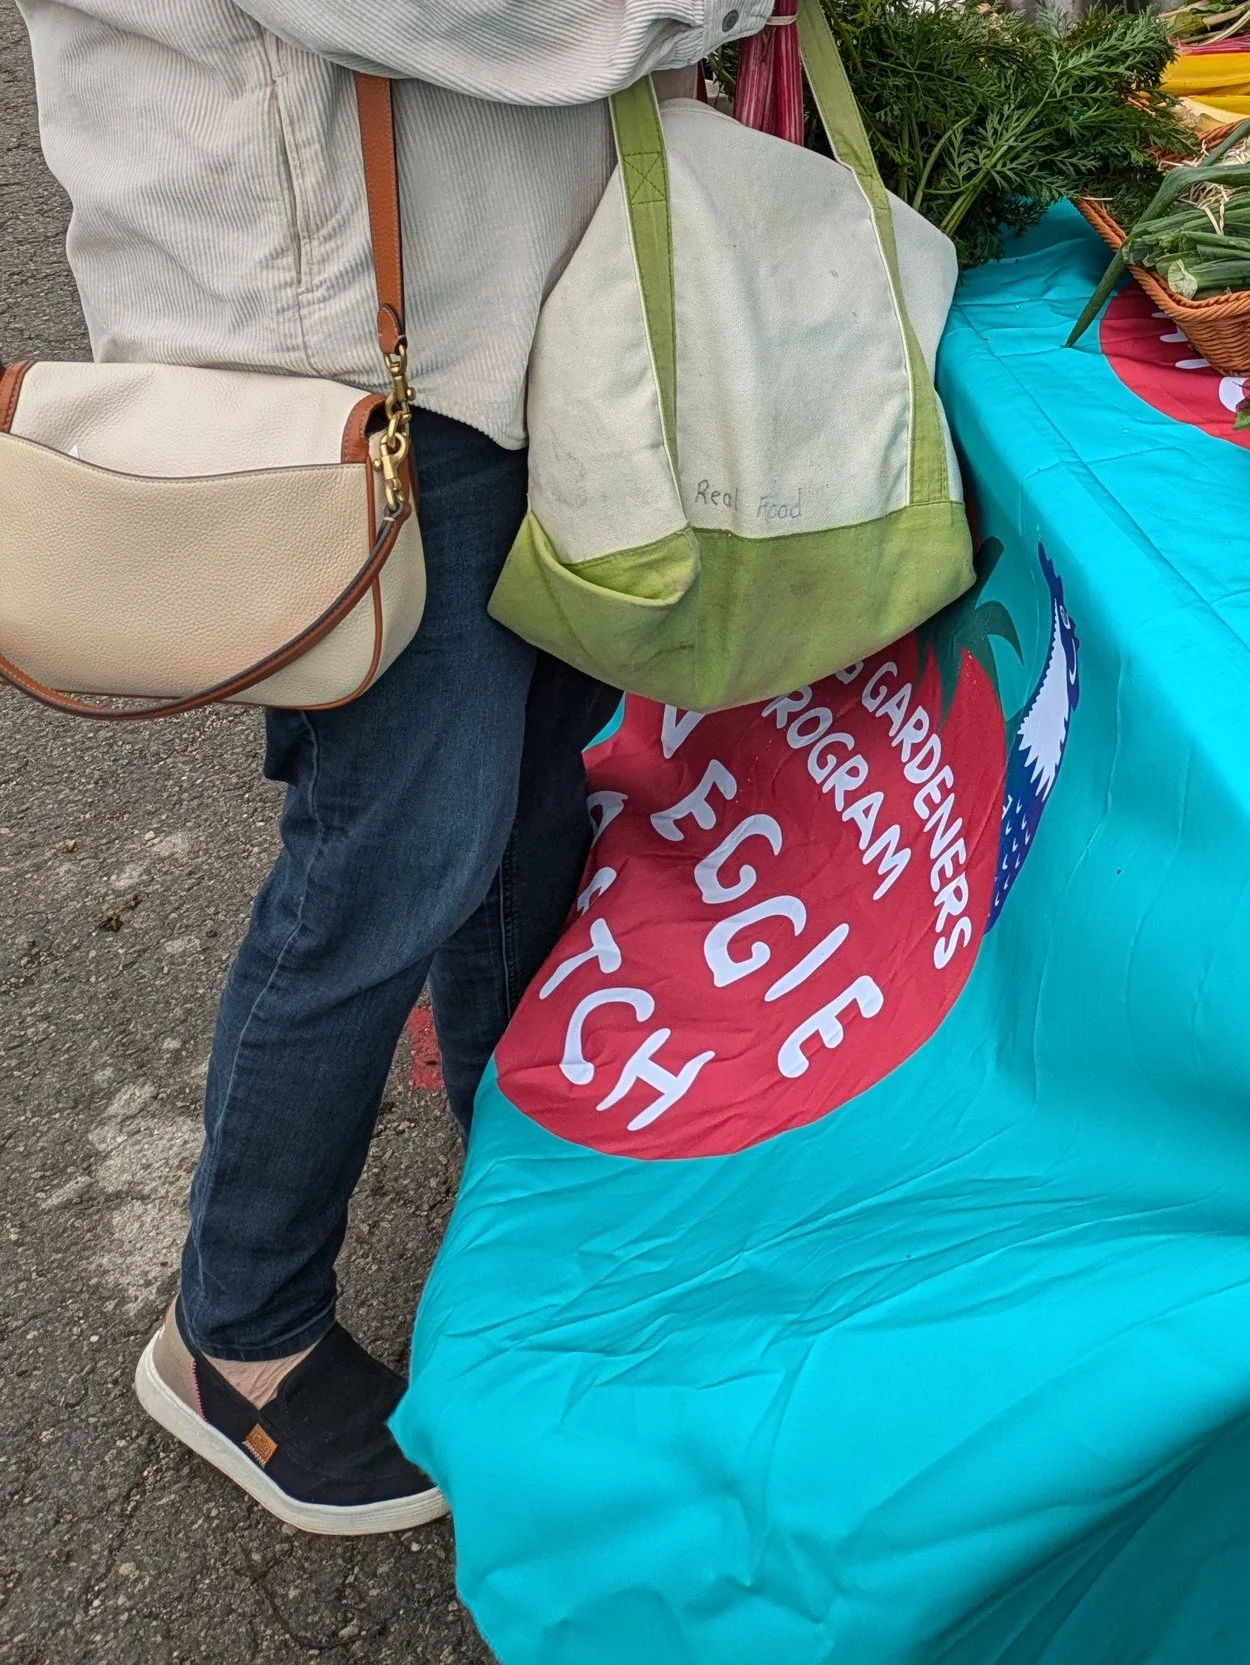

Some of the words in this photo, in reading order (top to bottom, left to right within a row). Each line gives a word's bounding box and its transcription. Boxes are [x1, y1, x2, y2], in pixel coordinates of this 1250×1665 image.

[694, 479, 738, 511] Real
[650, 705, 884, 1078] VEGGIE
[762, 685, 911, 901] ROGRAM
[861, 661, 972, 970] GARDENERS
